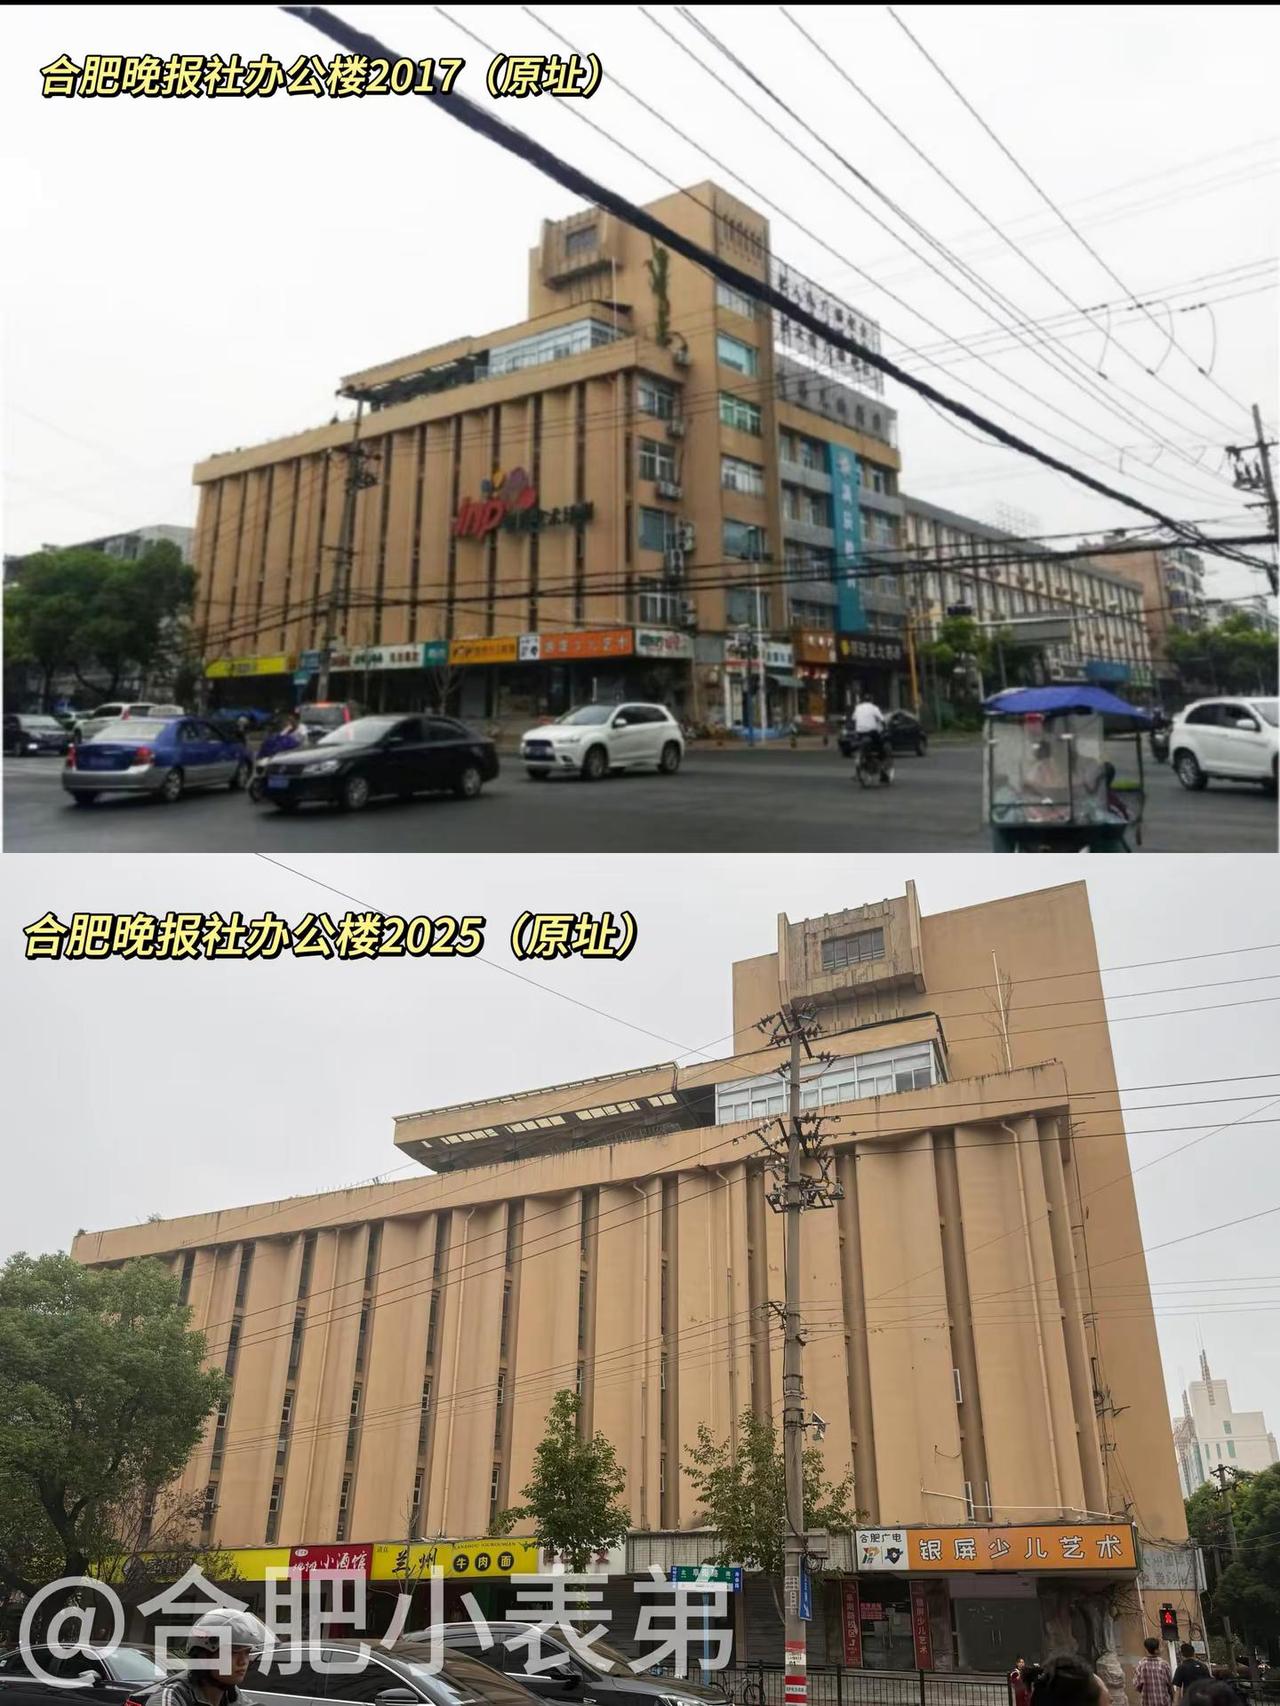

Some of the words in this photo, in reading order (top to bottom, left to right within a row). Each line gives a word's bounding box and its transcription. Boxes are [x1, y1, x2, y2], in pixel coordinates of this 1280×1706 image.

[859, 1532, 903, 1544] 合肥广电
[919, 1535, 1123, 1561] 银屏少儿艺术
[392, 1546, 437, 1574] 兰州
[454, 1554, 512, 1570] 牛肉面
